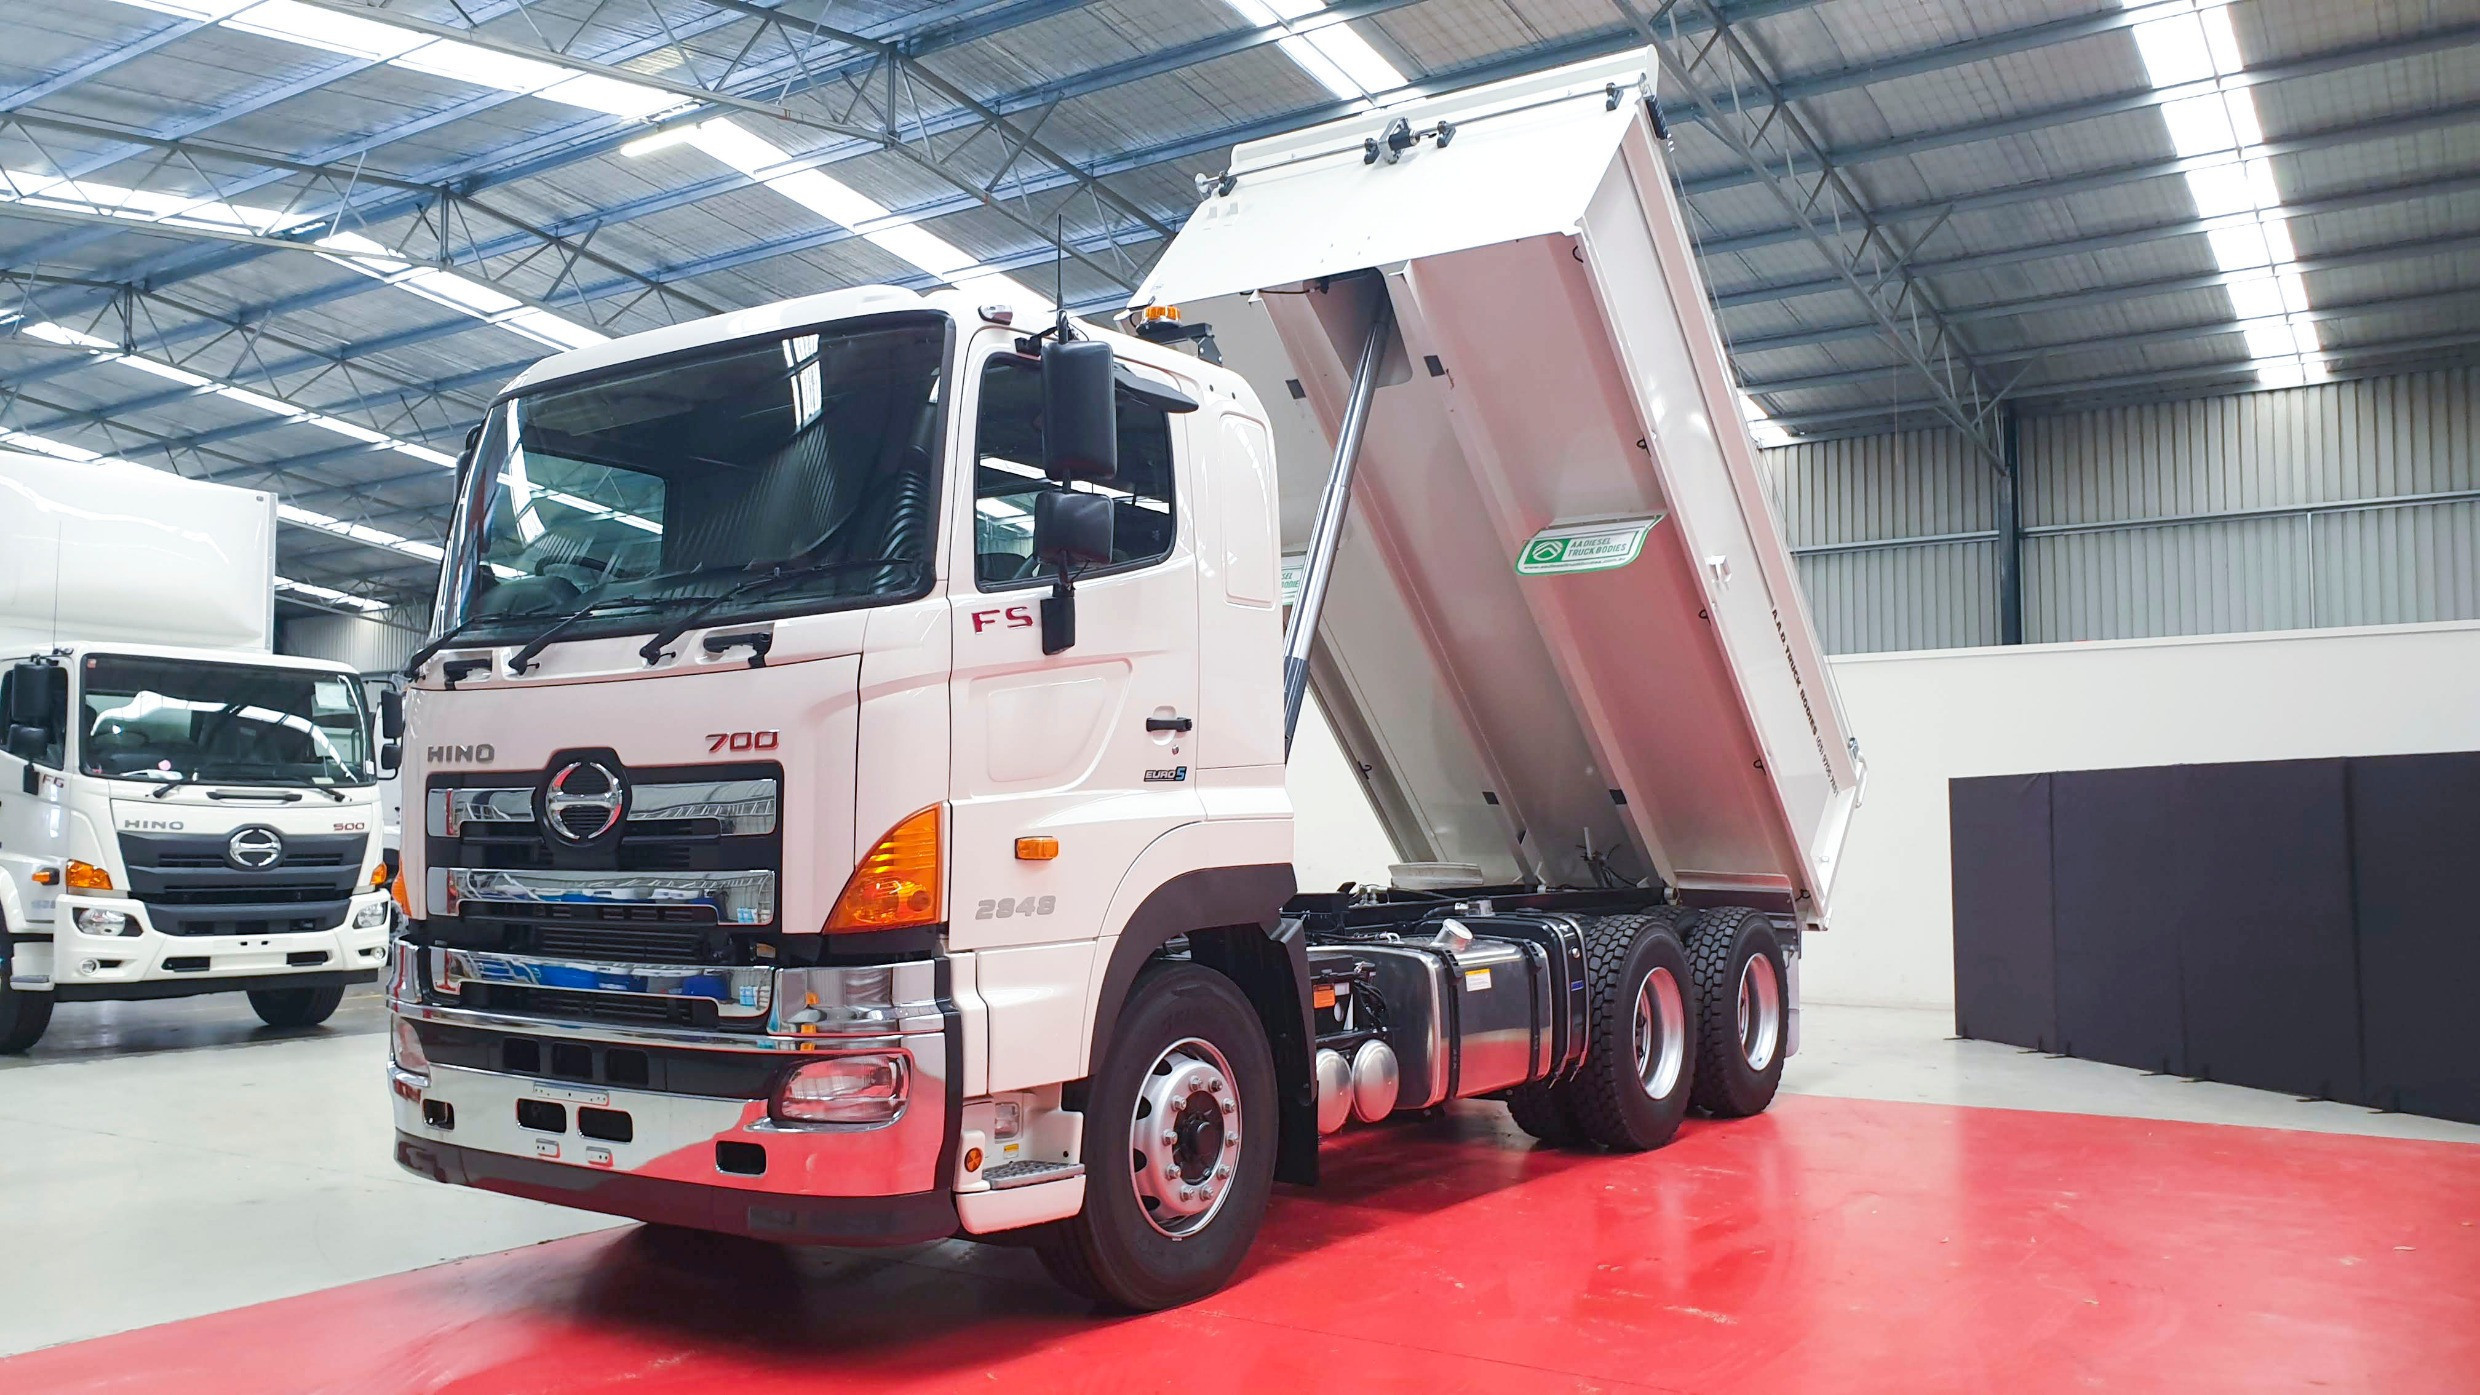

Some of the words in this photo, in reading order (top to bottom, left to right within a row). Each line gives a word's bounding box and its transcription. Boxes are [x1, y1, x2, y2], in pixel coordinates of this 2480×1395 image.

[1568, 547, 1596, 557] TRUCK
[1596, 543, 1627, 554] BODIES
[1583, 537, 1611, 547] DIESEL
[971, 606, 1034, 635] FS
[1785, 644, 1801, 688] TRUCK
[1800, 688, 1817, 736] BODIES
[705, 730, 780, 753] 700
[427, 743, 495, 764] HINO
[42, 774, 65, 788] FG
[124, 819, 184, 830] HINO
[333, 822, 365, 831] 500
[975, 895, 1056, 920] 2848
